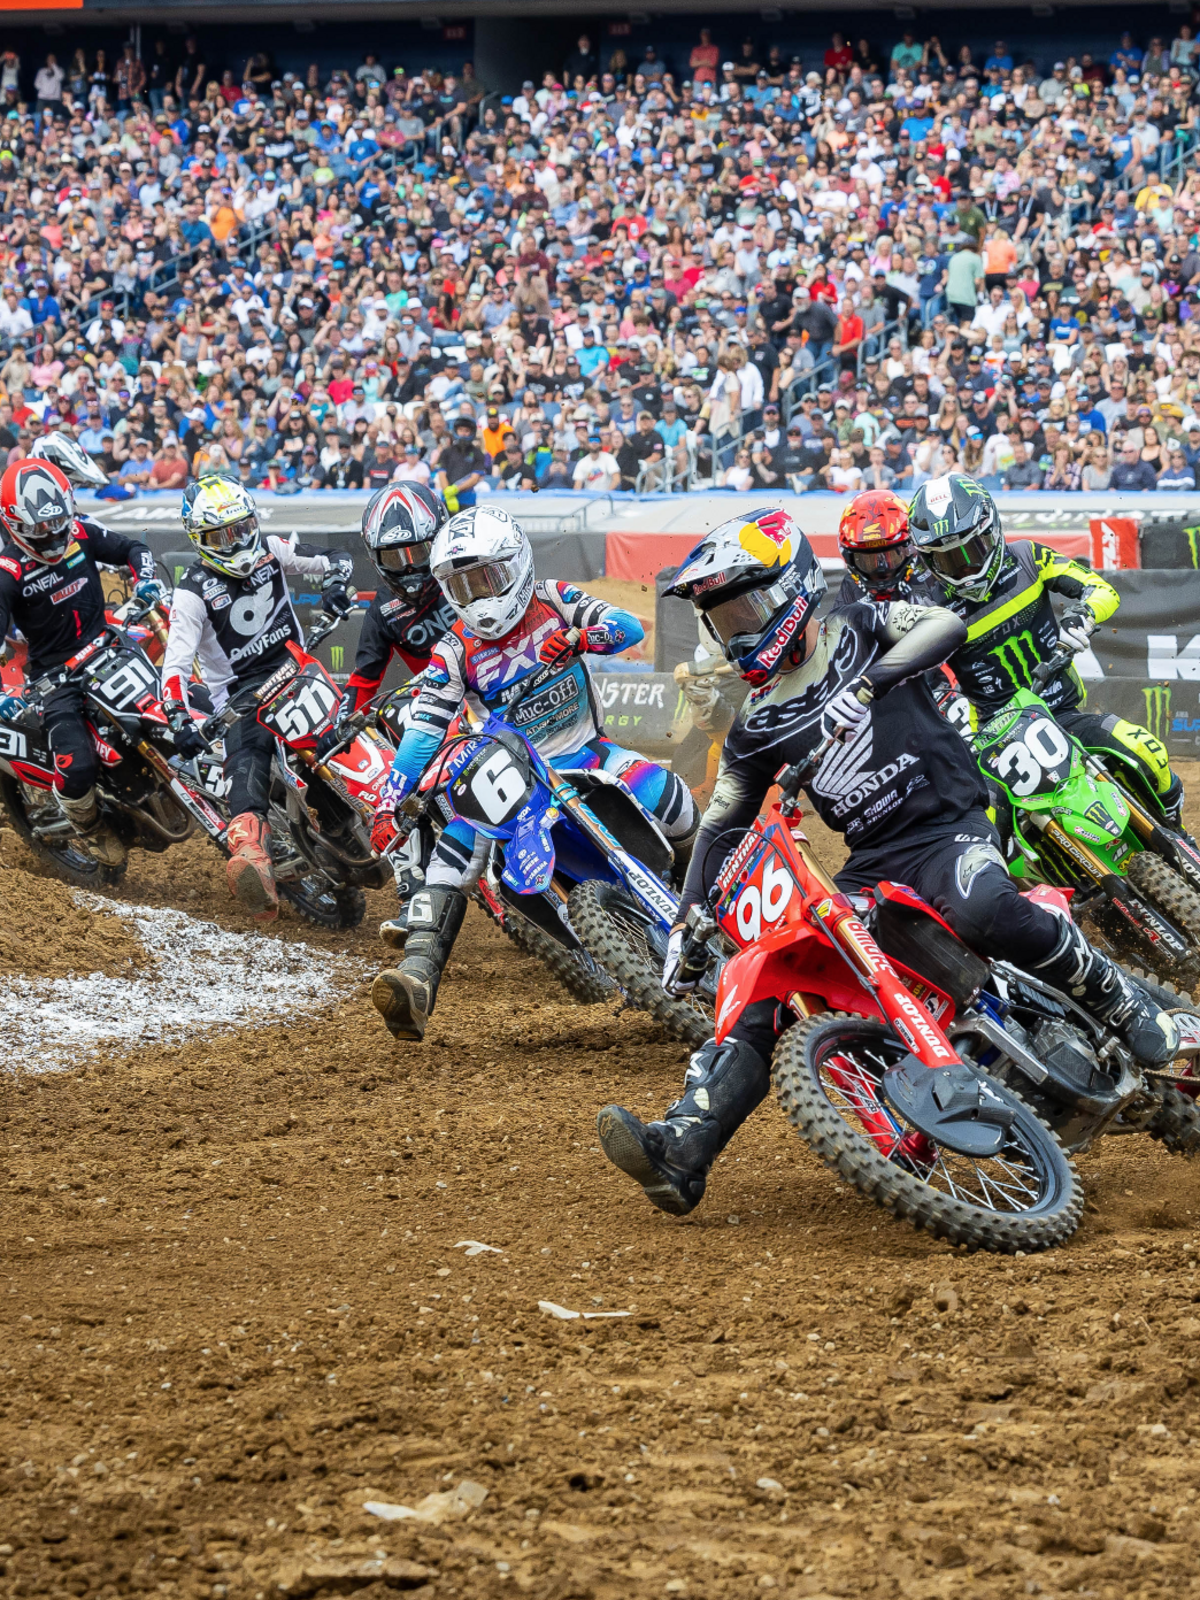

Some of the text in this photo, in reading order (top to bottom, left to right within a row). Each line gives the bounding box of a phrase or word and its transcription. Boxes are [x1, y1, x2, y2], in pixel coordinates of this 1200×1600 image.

[230, 624, 292, 662] OnlyFans
[100, 656, 155, 710] 91
[275, 672, 338, 742] 511
[470, 748, 527, 826] 6
[830, 753, 920, 818] HONDA
[998, 717, 1069, 796] 30
[863, 788, 899, 818] SHOWA
[721, 832, 759, 889] RENTHA
[736, 848, 794, 942] 96
[1128, 898, 1186, 951] DUNLOP
[893, 992, 950, 1059] DUNLOP
